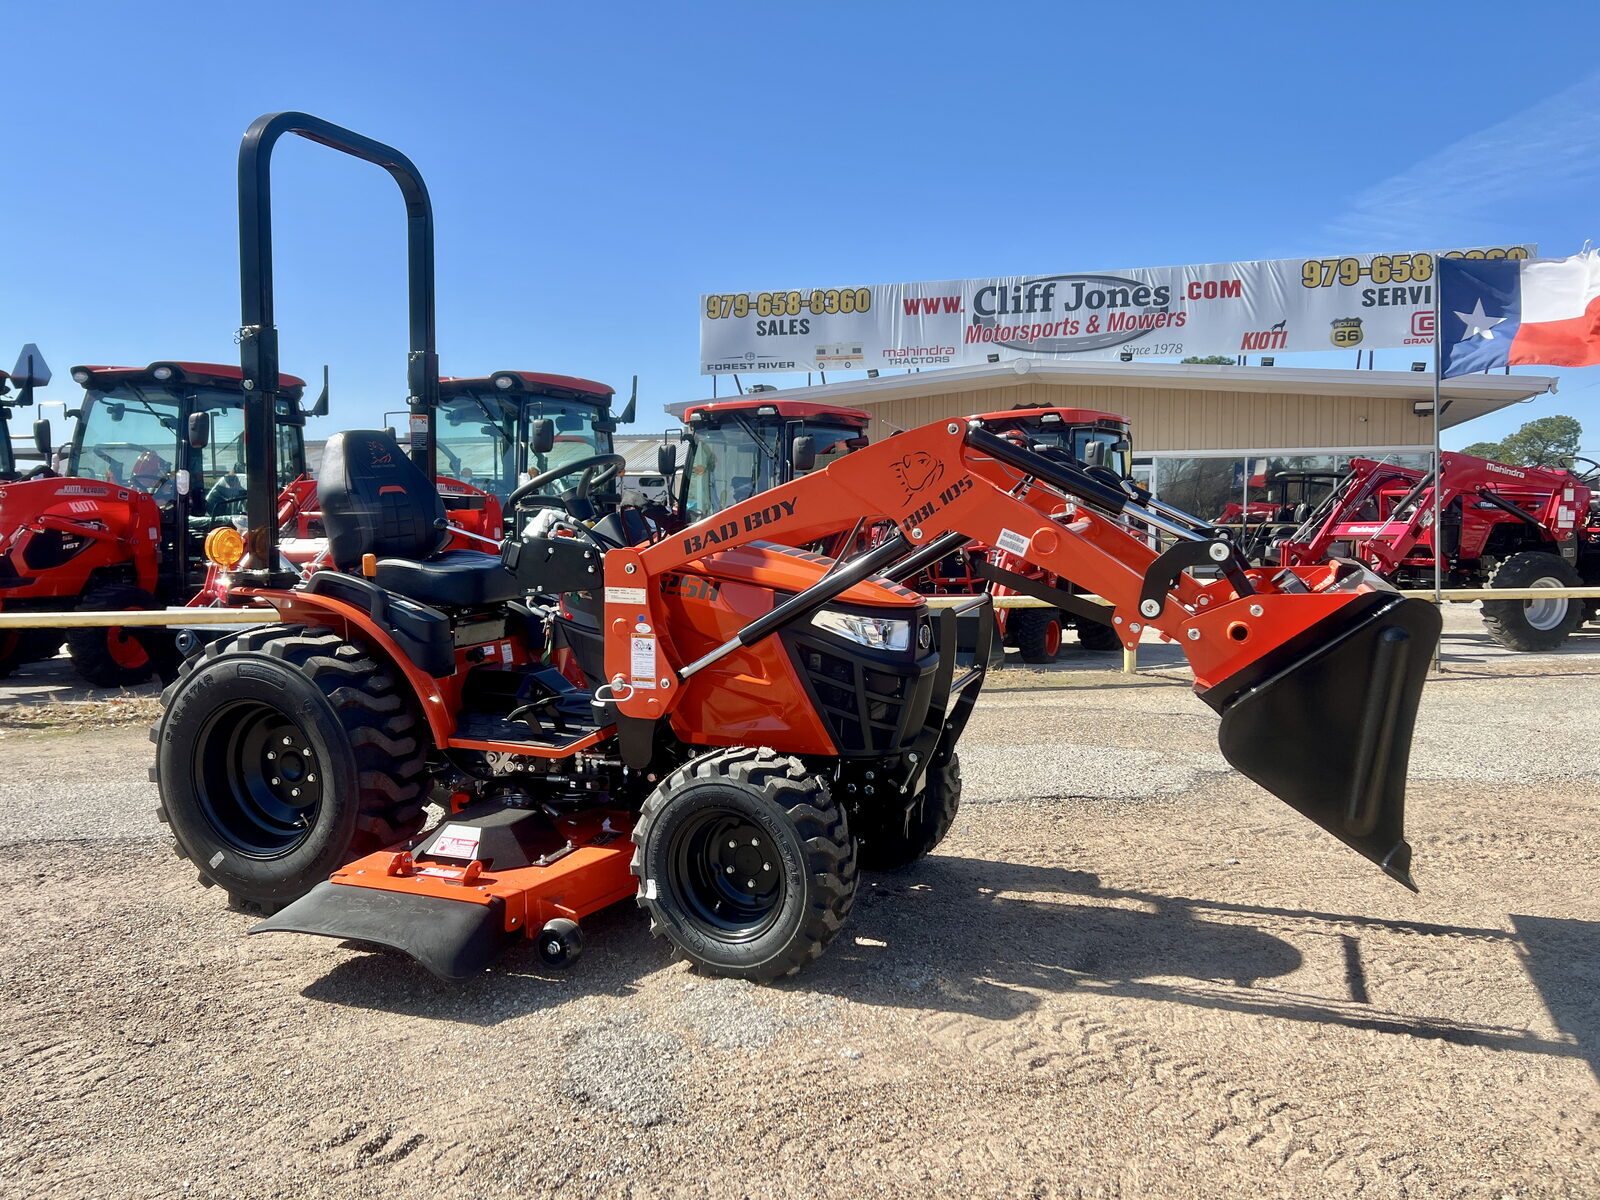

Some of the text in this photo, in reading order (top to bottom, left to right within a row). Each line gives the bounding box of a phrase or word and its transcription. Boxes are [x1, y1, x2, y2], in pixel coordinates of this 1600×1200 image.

[706, 288, 871, 319] 979-658-8360
[973, 282, 1056, 317] Cliff
[1064, 282, 1170, 312] Jones
[1180, 280, 1241, 300] .COM
[1361, 286, 1432, 307] SERVI
[756, 319, 810, 336] SALES
[965, 311, 1187, 344] Motorsports & Mowers
[1334, 330, 1359, 342] 66
[1123, 343, 1183, 355] Since 1978
[1241, 331, 1288, 350] KIOTI
[883, 345, 955, 357] mahindra
[707, 361, 795, 371] FOREST RIVER
[888, 356, 950, 365] TRACTORS
[1486, 462, 1525, 479] Mahindra
[68, 500, 98, 513] KIOTI
[902, 474, 973, 532] BBL 105
[683, 496, 798, 555] BAD BOY
